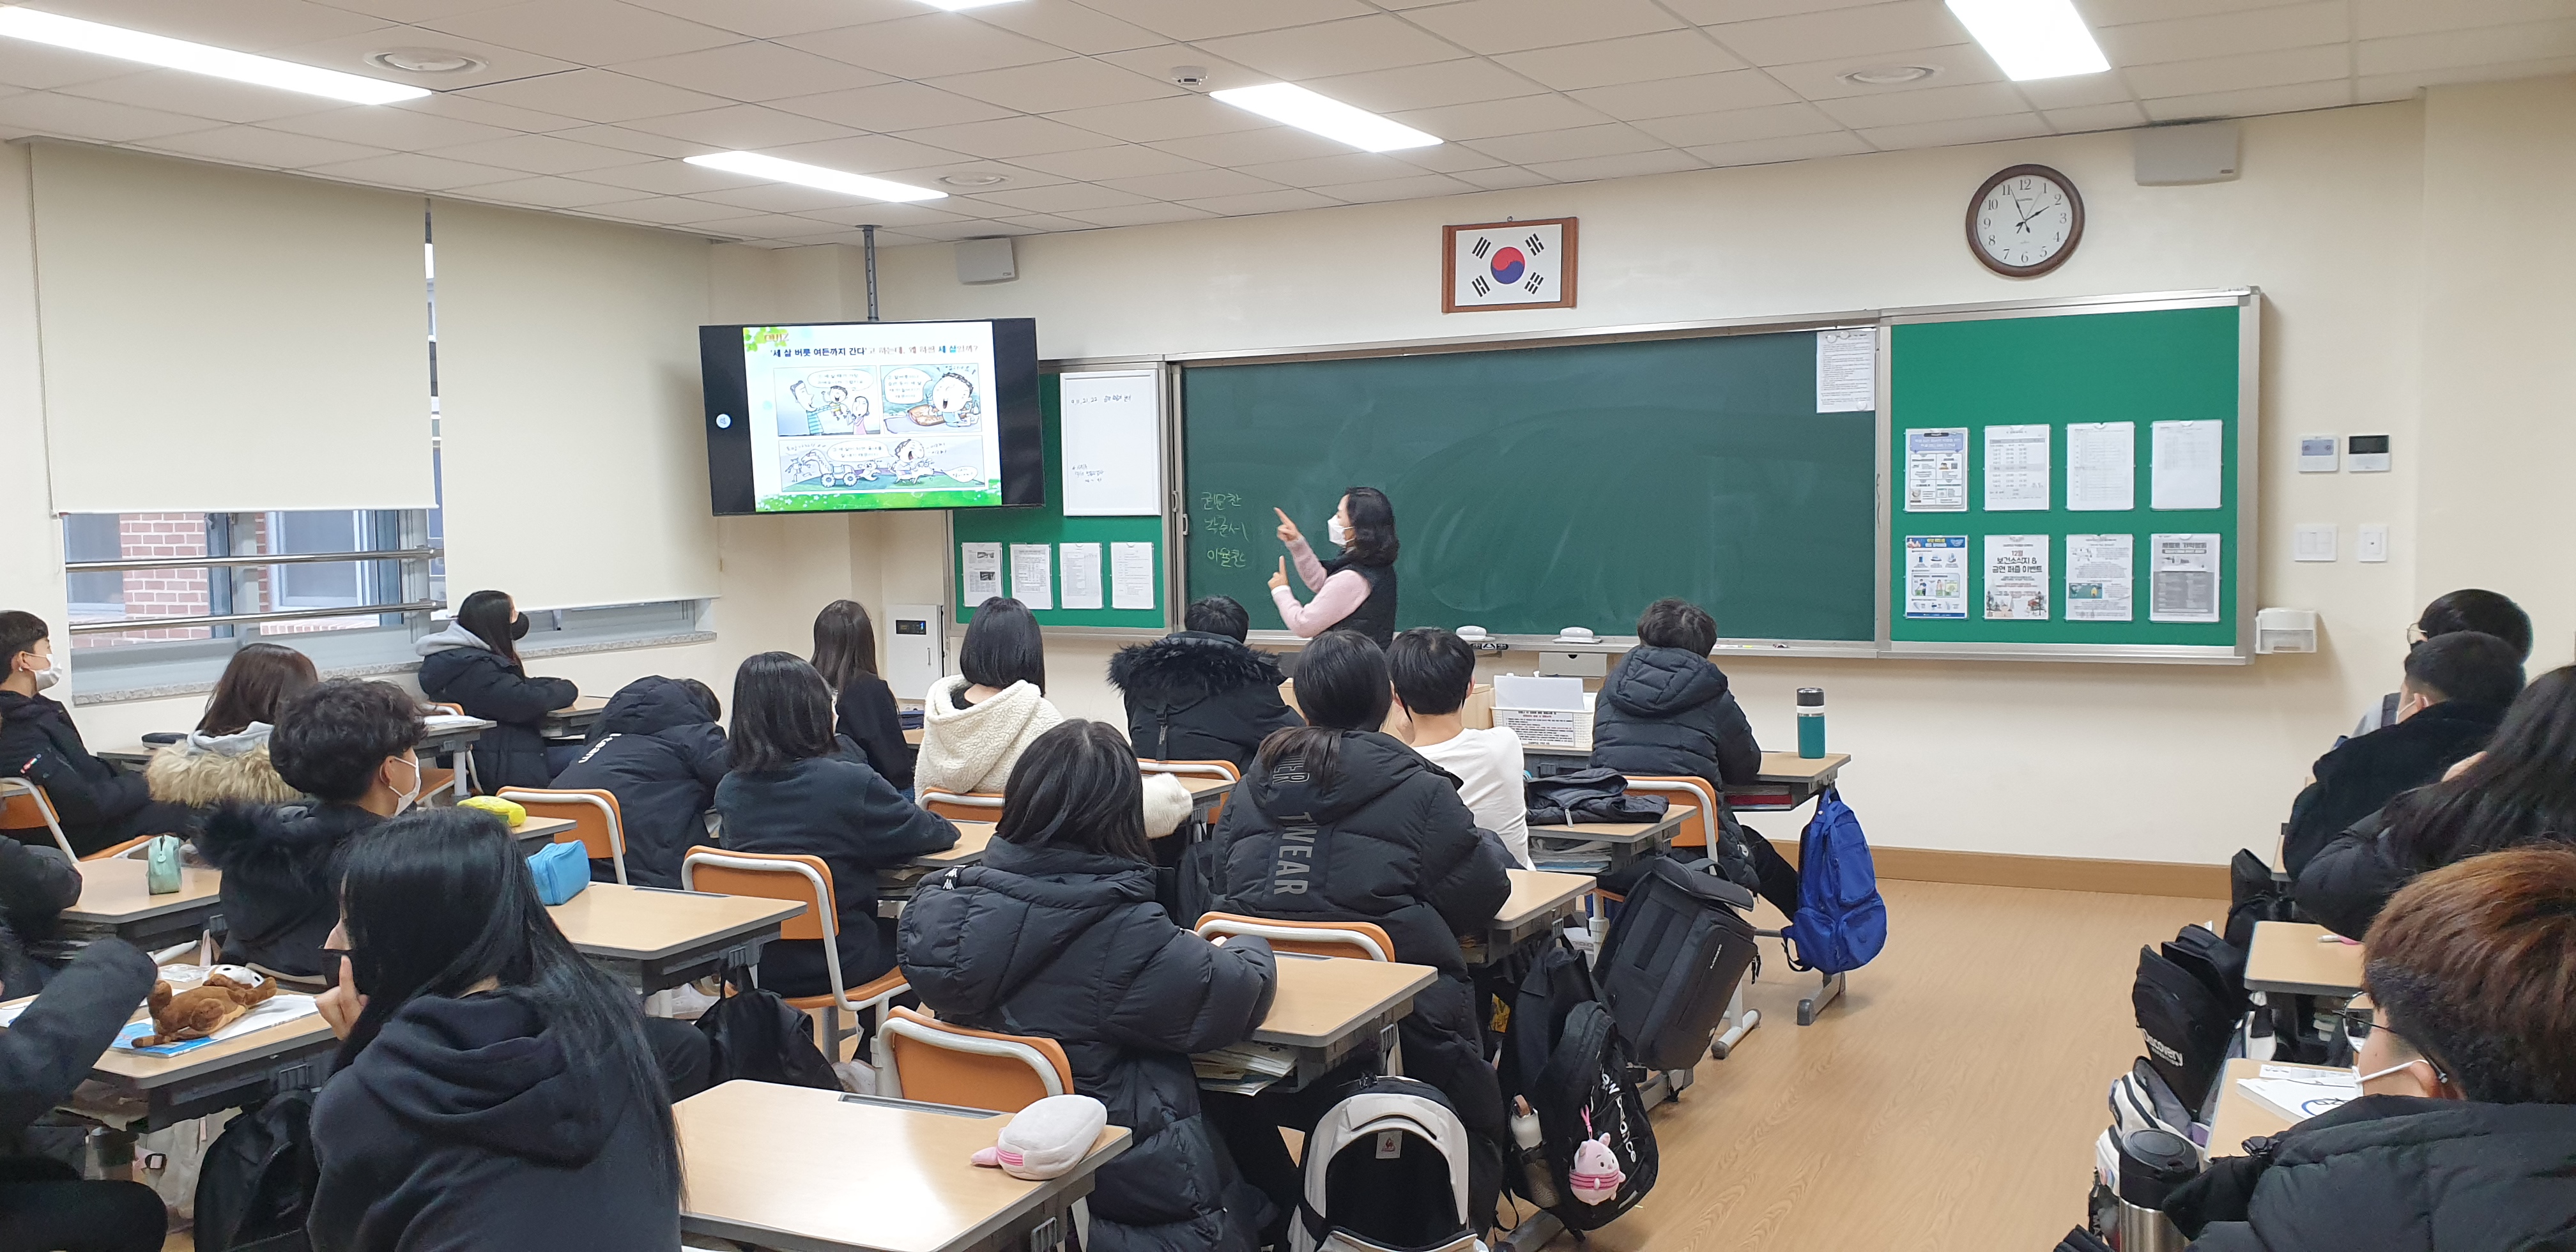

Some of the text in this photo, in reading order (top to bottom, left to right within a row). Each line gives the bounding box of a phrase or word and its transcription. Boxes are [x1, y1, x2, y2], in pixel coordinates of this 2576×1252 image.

[2002, 184, 2011, 195] 11
[2019, 178, 2032, 190] 12
[2043, 182, 2047, 194] 1
[1988, 199, 1998, 210] 10
[2054, 194, 2062, 206] 2
[1983, 217, 1991, 229] 9
[2059, 213, 2067, 224] 3
[1988, 234, 1996, 246] 8
[2053, 231, 2060, 242] 4
[2003, 248, 2010, 259] 7
[2021, 251, 2028, 263] 6
[2039, 246, 2048, 257] 5
[794, 348, 811, 356] 버릇
[813, 347, 846, 356] 여든까지
